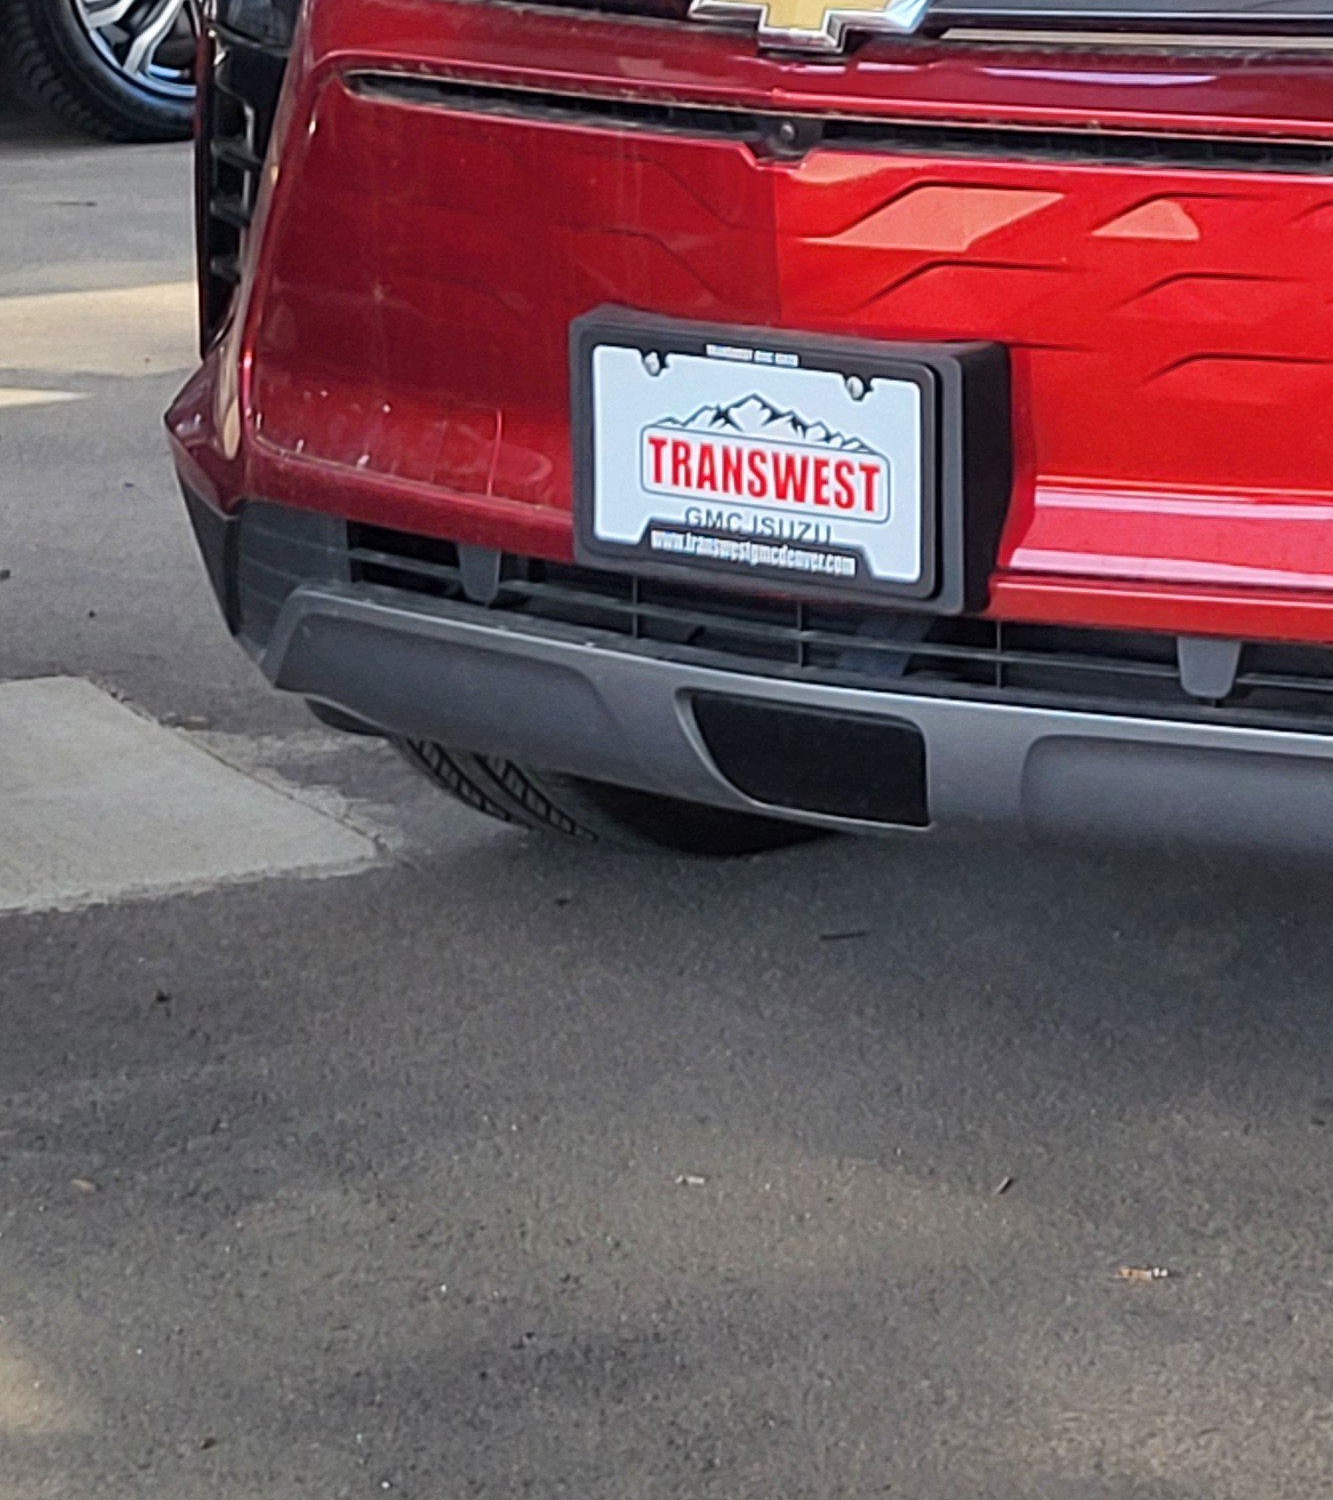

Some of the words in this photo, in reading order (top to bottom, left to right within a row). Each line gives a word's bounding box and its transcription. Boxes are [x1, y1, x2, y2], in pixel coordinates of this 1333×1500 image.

[648, 435, 881, 512] TRANSWEST
[684, 506, 743, 534] GMC
[752, 514, 832, 545] ISUZU
